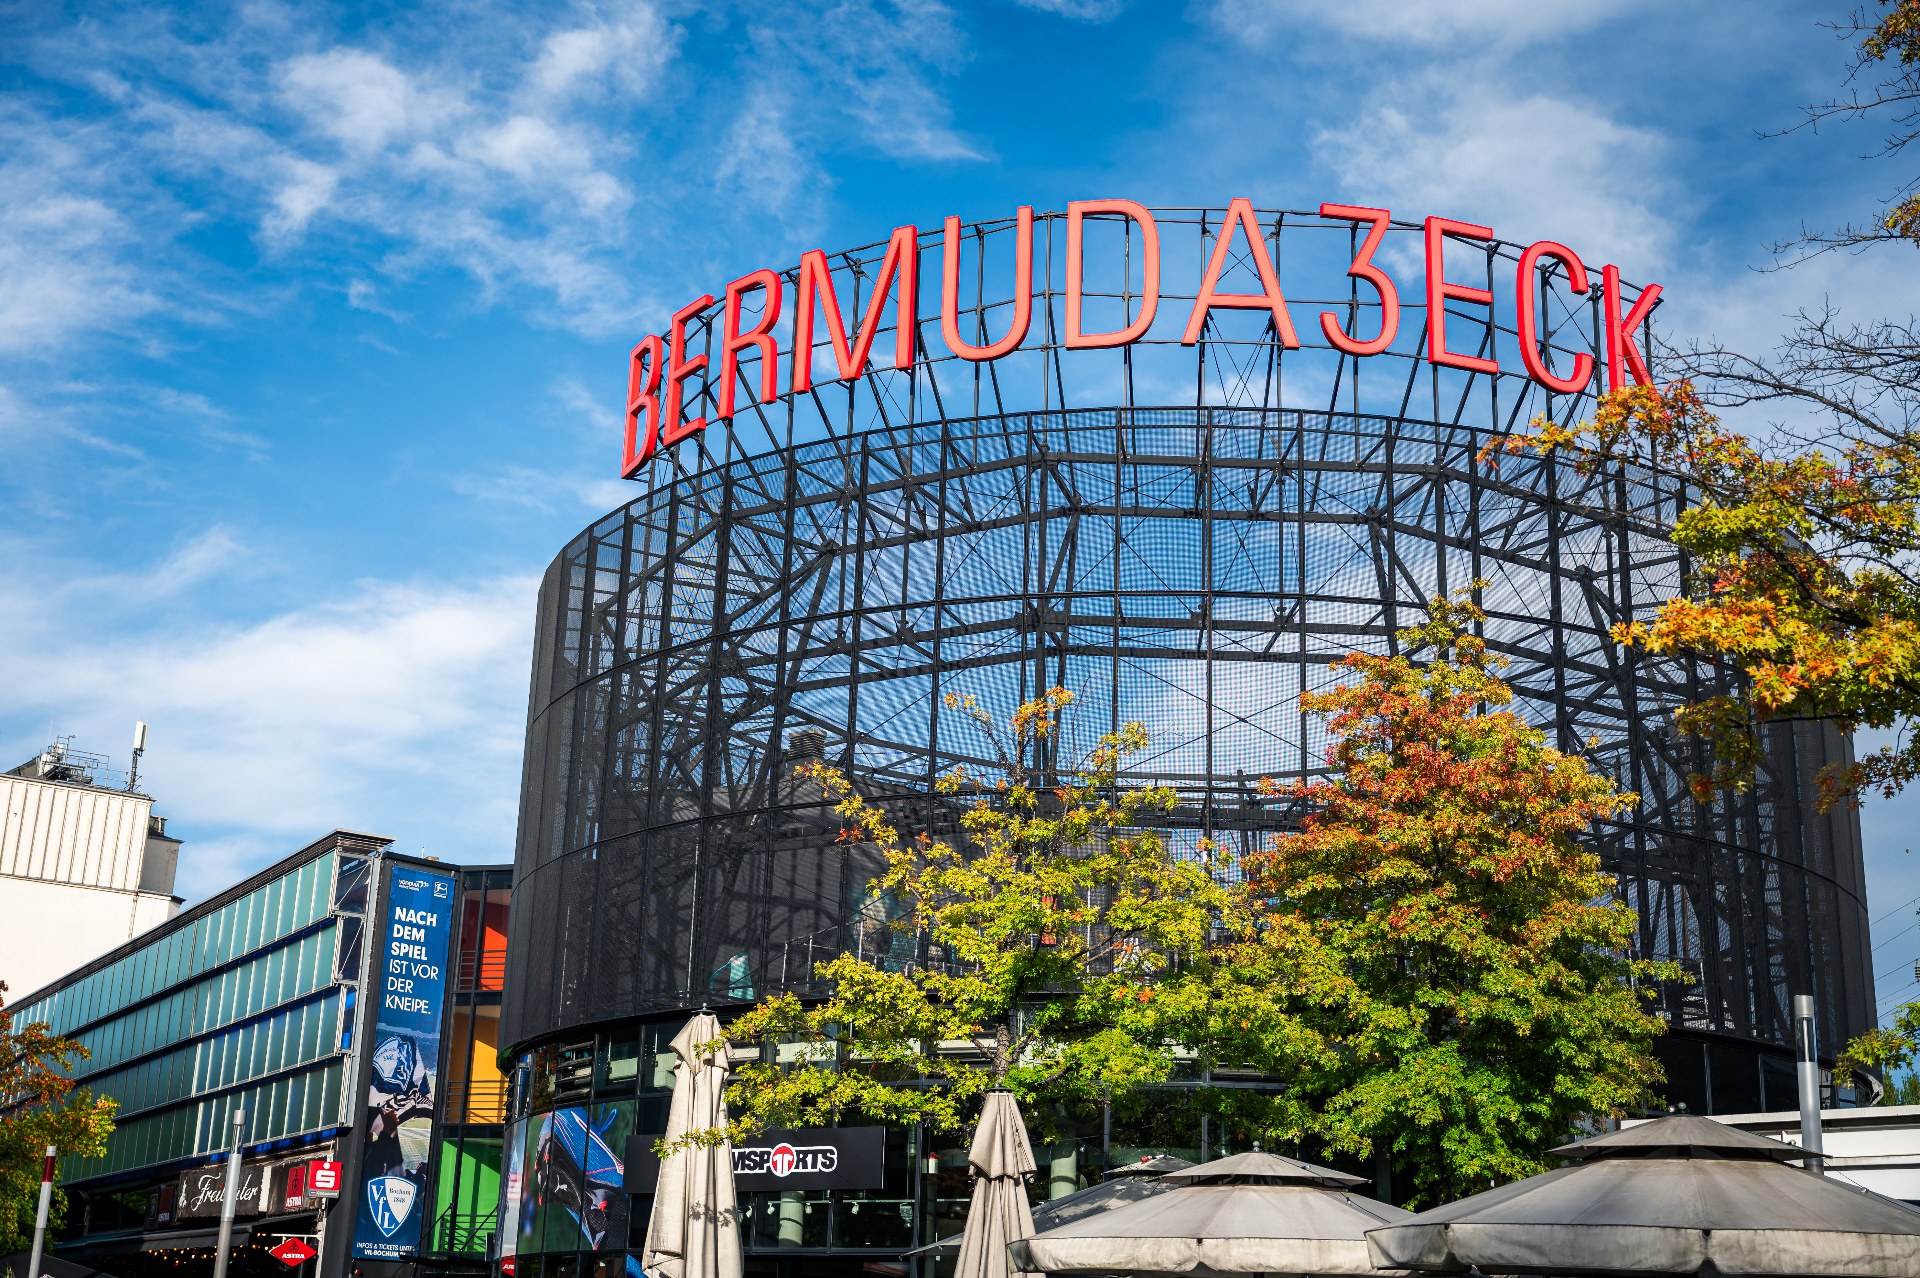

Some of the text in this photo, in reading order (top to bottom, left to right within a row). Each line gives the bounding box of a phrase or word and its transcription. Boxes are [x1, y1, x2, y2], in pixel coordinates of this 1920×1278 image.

[621, 198, 1664, 480] BERMUDA3ECK
[394, 906, 437, 927] NACH
[393, 924, 425, 942] DEM
[390, 941, 428, 960] SPIEL
[389, 958, 439, 980] IST VOR
[387, 976, 414, 994] DER
[385, 994, 431, 1015] KNEIPE.
[389, 1187, 411, 1196] Bochum
[285, 1195, 302, 1207] ASTRA
[378, 1243, 399, 1251] TICKETS
